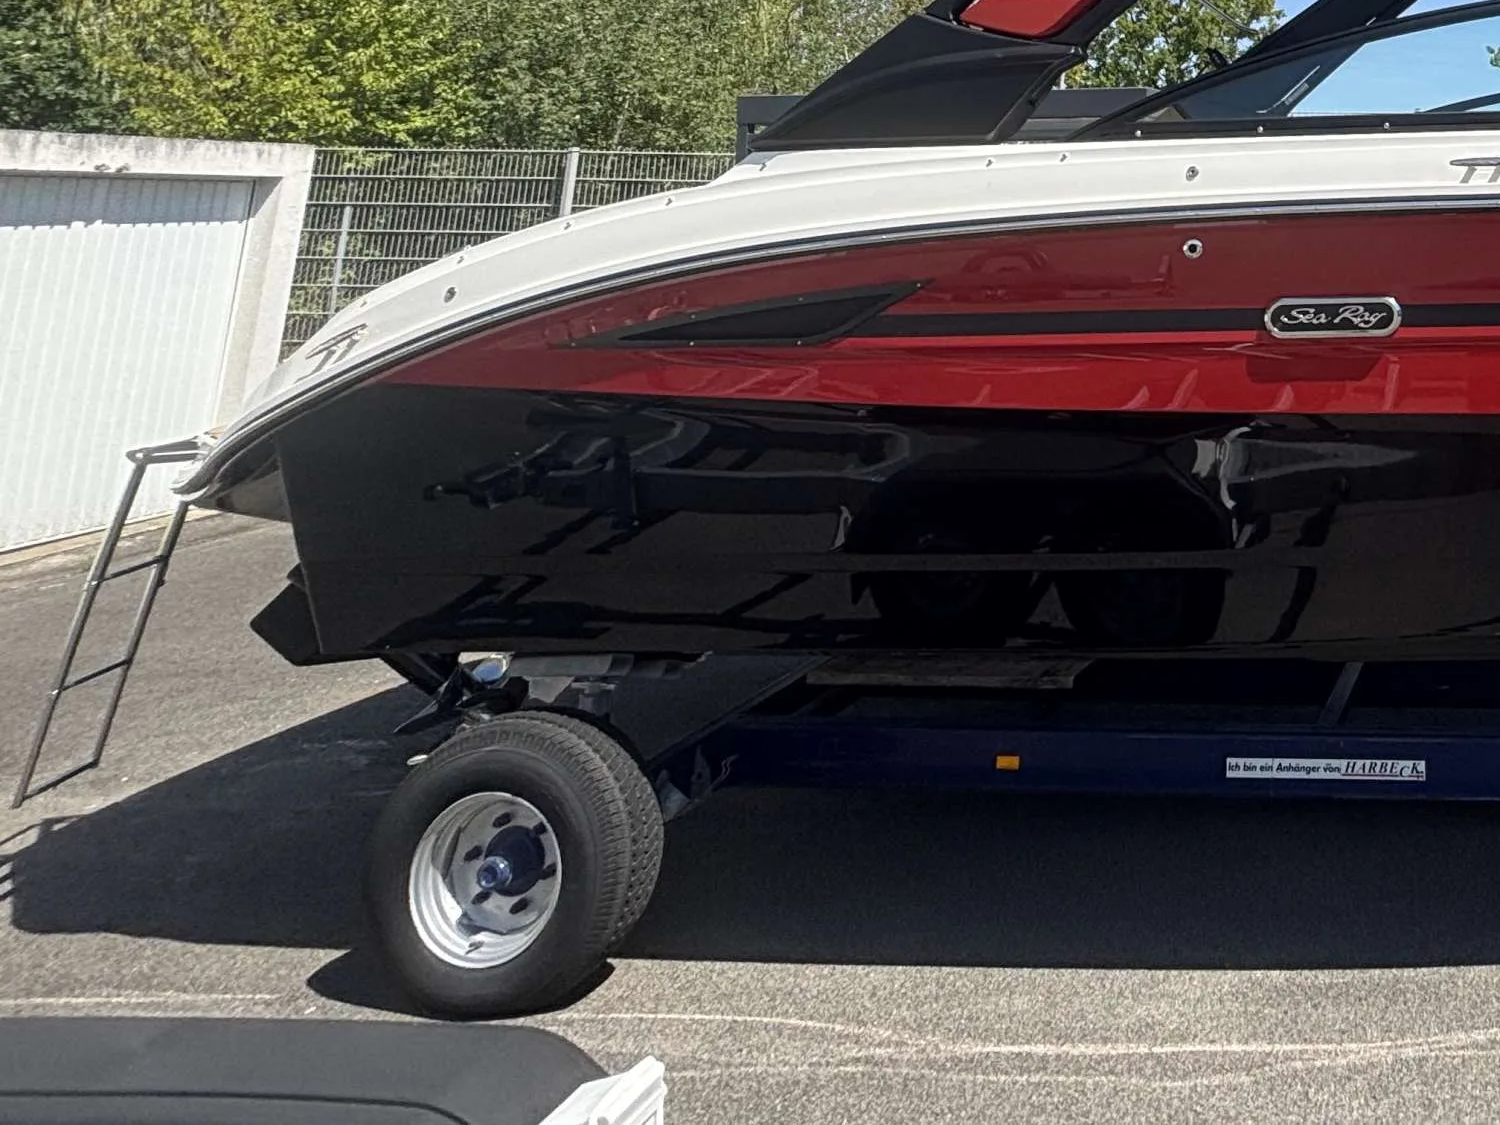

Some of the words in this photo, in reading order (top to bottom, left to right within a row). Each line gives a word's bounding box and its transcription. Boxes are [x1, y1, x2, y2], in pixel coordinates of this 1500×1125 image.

[1280, 308, 1331, 324] Sea
[1333, 305, 1387, 328] Ray
[1228, 762, 1241, 772] Ich
[1243, 762, 1257, 772] bin
[1260, 763, 1273, 772] ein
[1276, 763, 1321, 775] Anhänger
